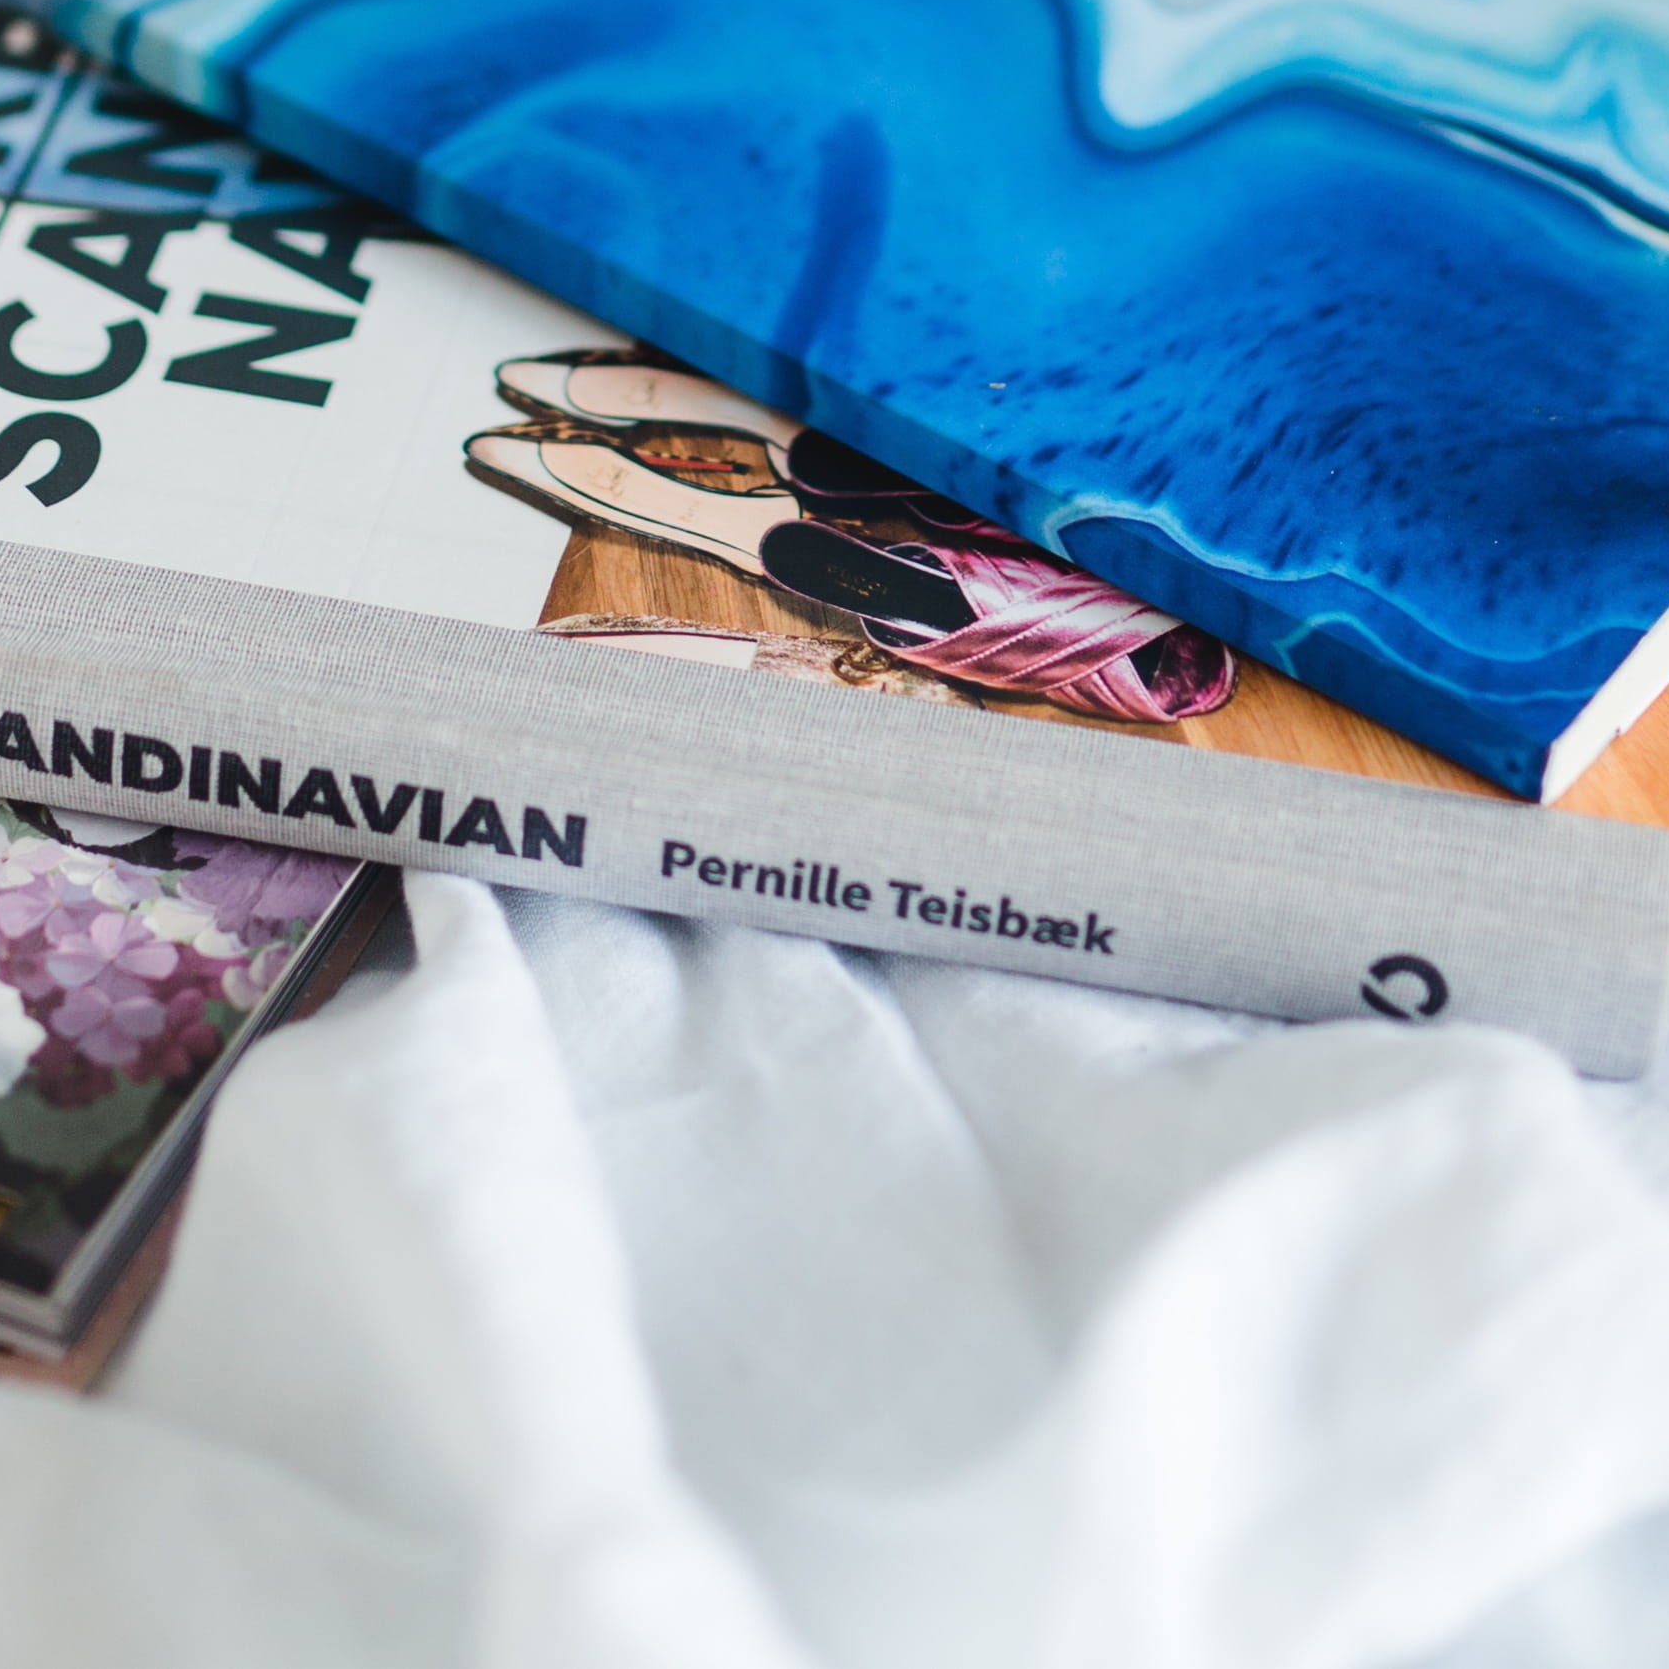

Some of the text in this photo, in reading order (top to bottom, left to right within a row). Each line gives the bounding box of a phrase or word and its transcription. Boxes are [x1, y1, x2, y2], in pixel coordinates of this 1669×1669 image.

[163, 149, 413, 407] NA
[660, 838, 1118, 957] Pernille Teisbæk
